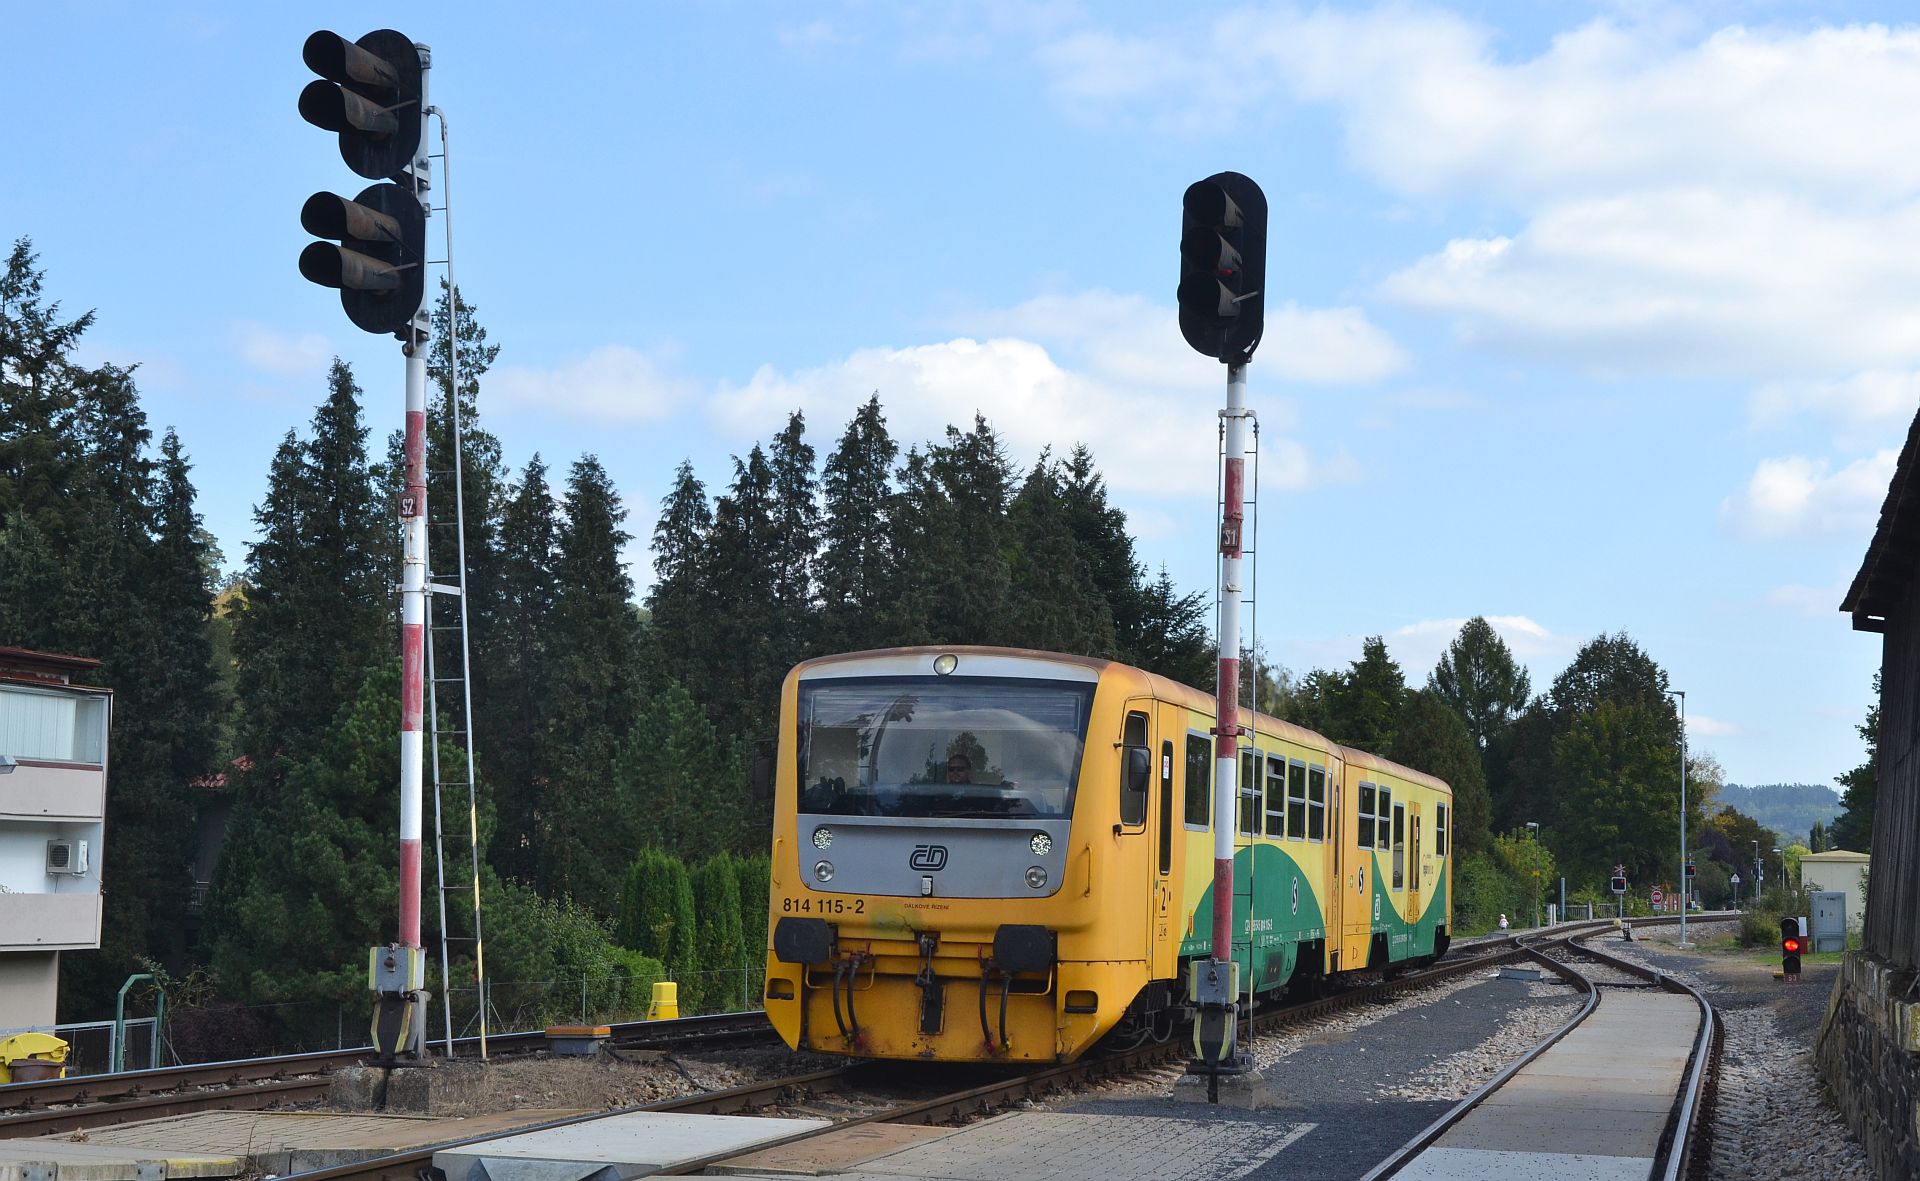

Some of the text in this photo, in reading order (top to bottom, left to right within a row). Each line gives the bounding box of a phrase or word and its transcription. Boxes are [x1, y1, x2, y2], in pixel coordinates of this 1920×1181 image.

[402, 498, 414, 515] S2
[1224, 529, 1237, 545] S1
[783, 897, 865, 914] 814 115-2
[1161, 887, 1166, 911] 2
